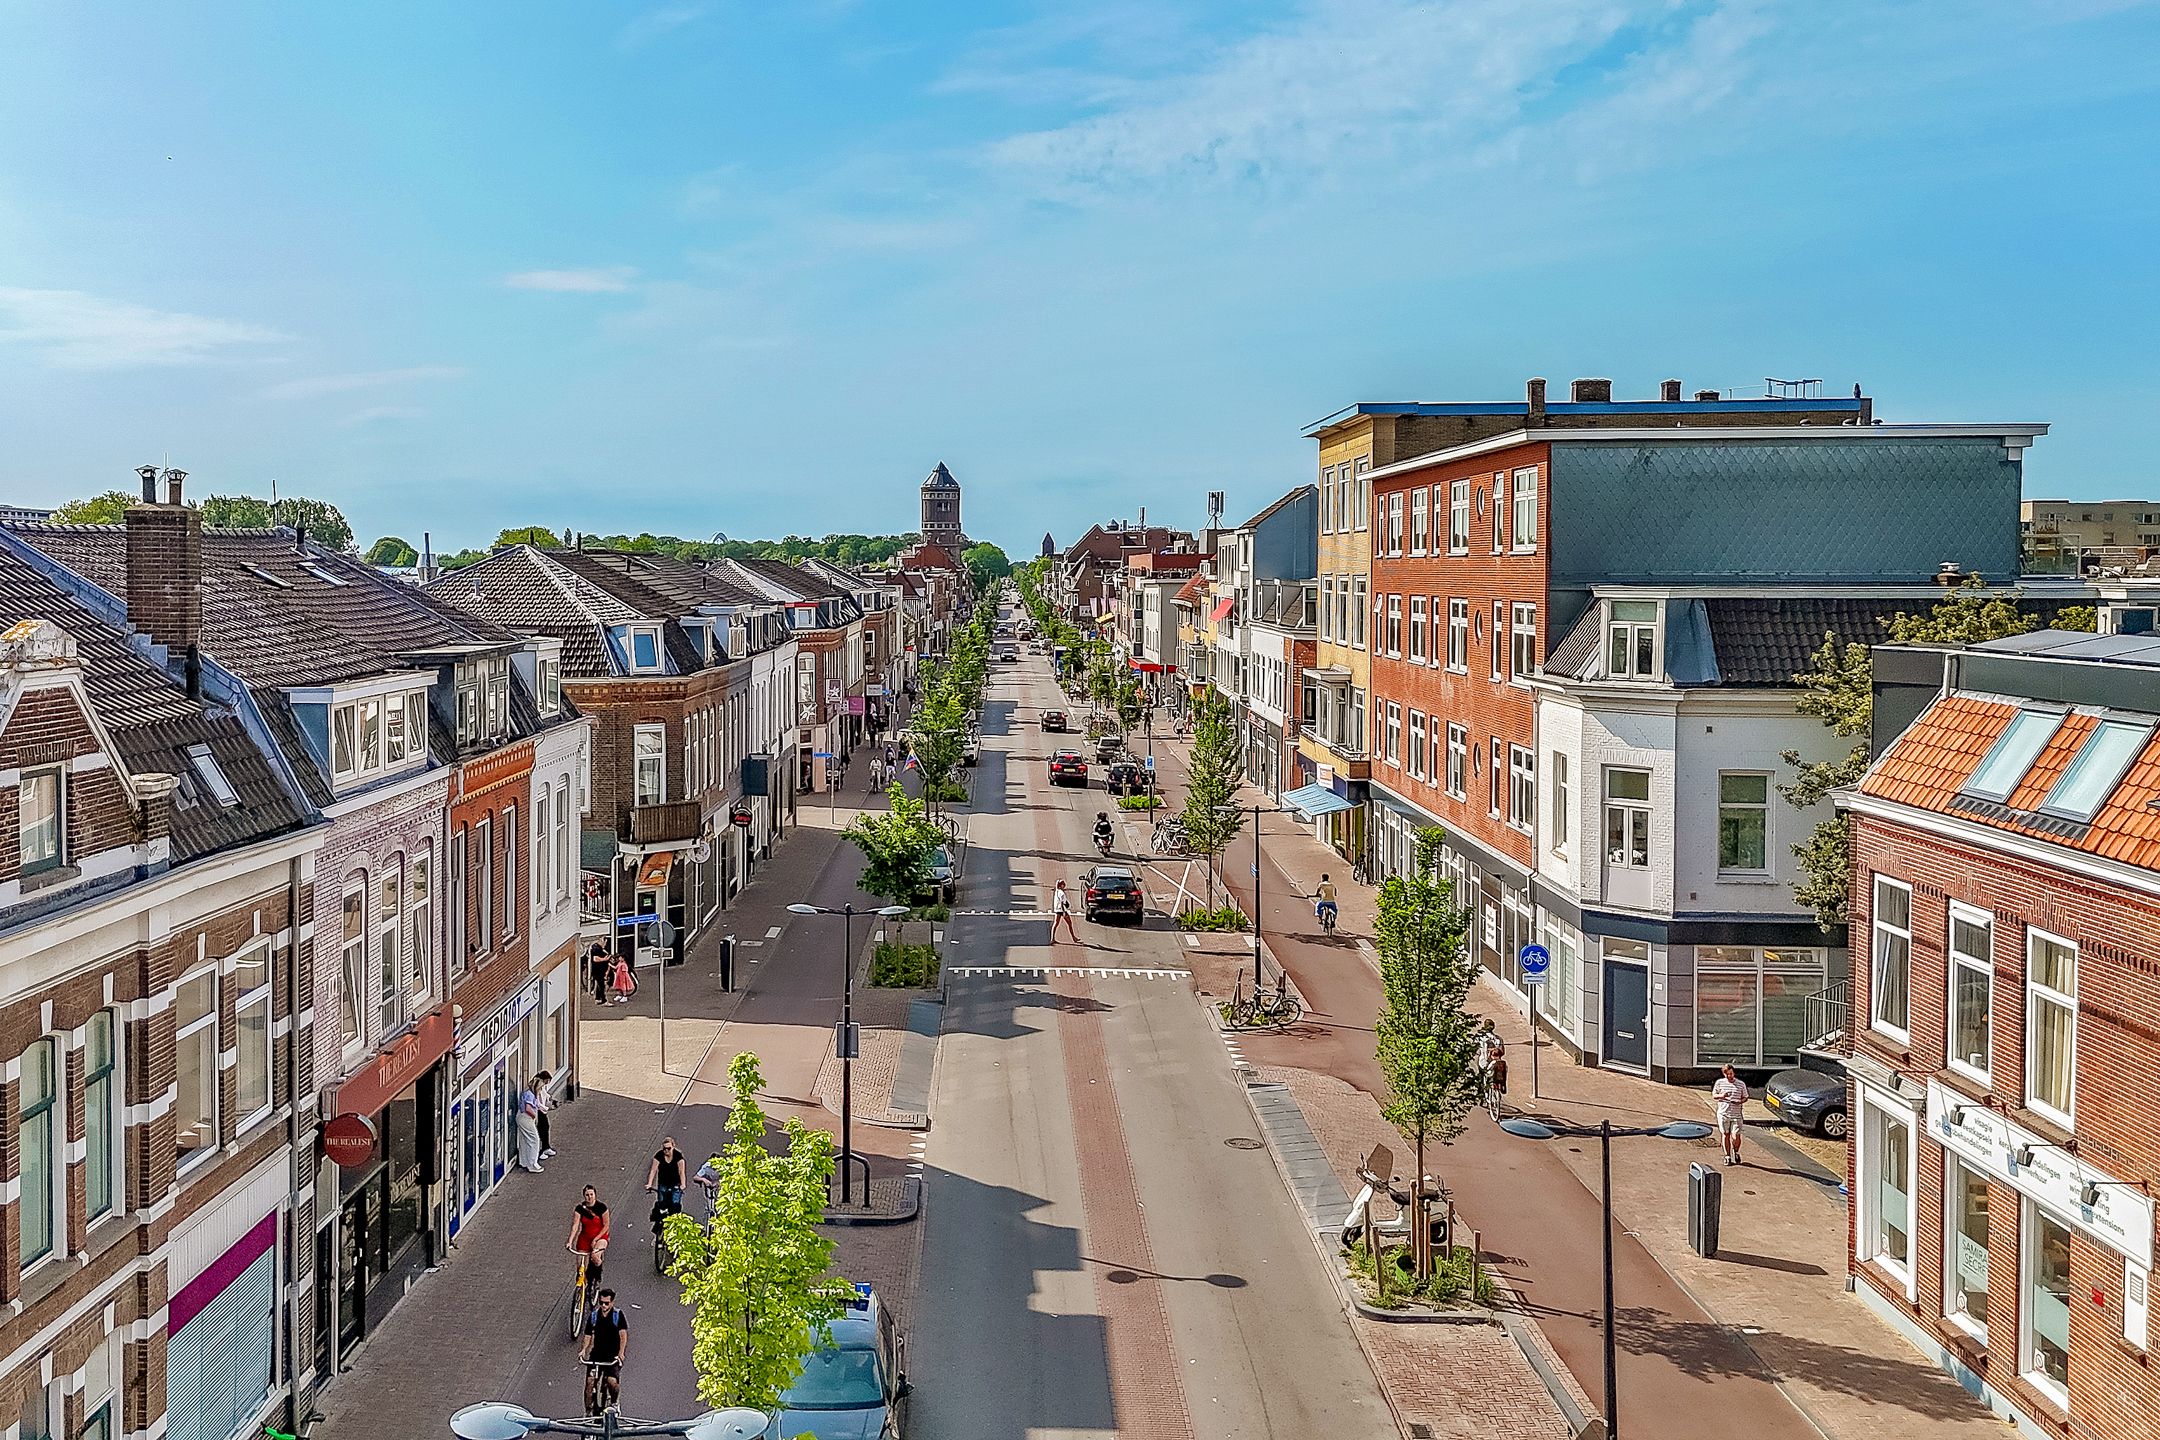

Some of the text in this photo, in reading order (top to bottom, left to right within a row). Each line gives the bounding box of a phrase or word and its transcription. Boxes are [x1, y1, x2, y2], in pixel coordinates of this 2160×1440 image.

[391, 1037, 420, 1079] REALEST
[326, 1137, 371, 1146] THE REALEST
[1961, 1124, 1992, 1145] eestkapsels
[1965, 1253, 1988, 1275] SECRE
